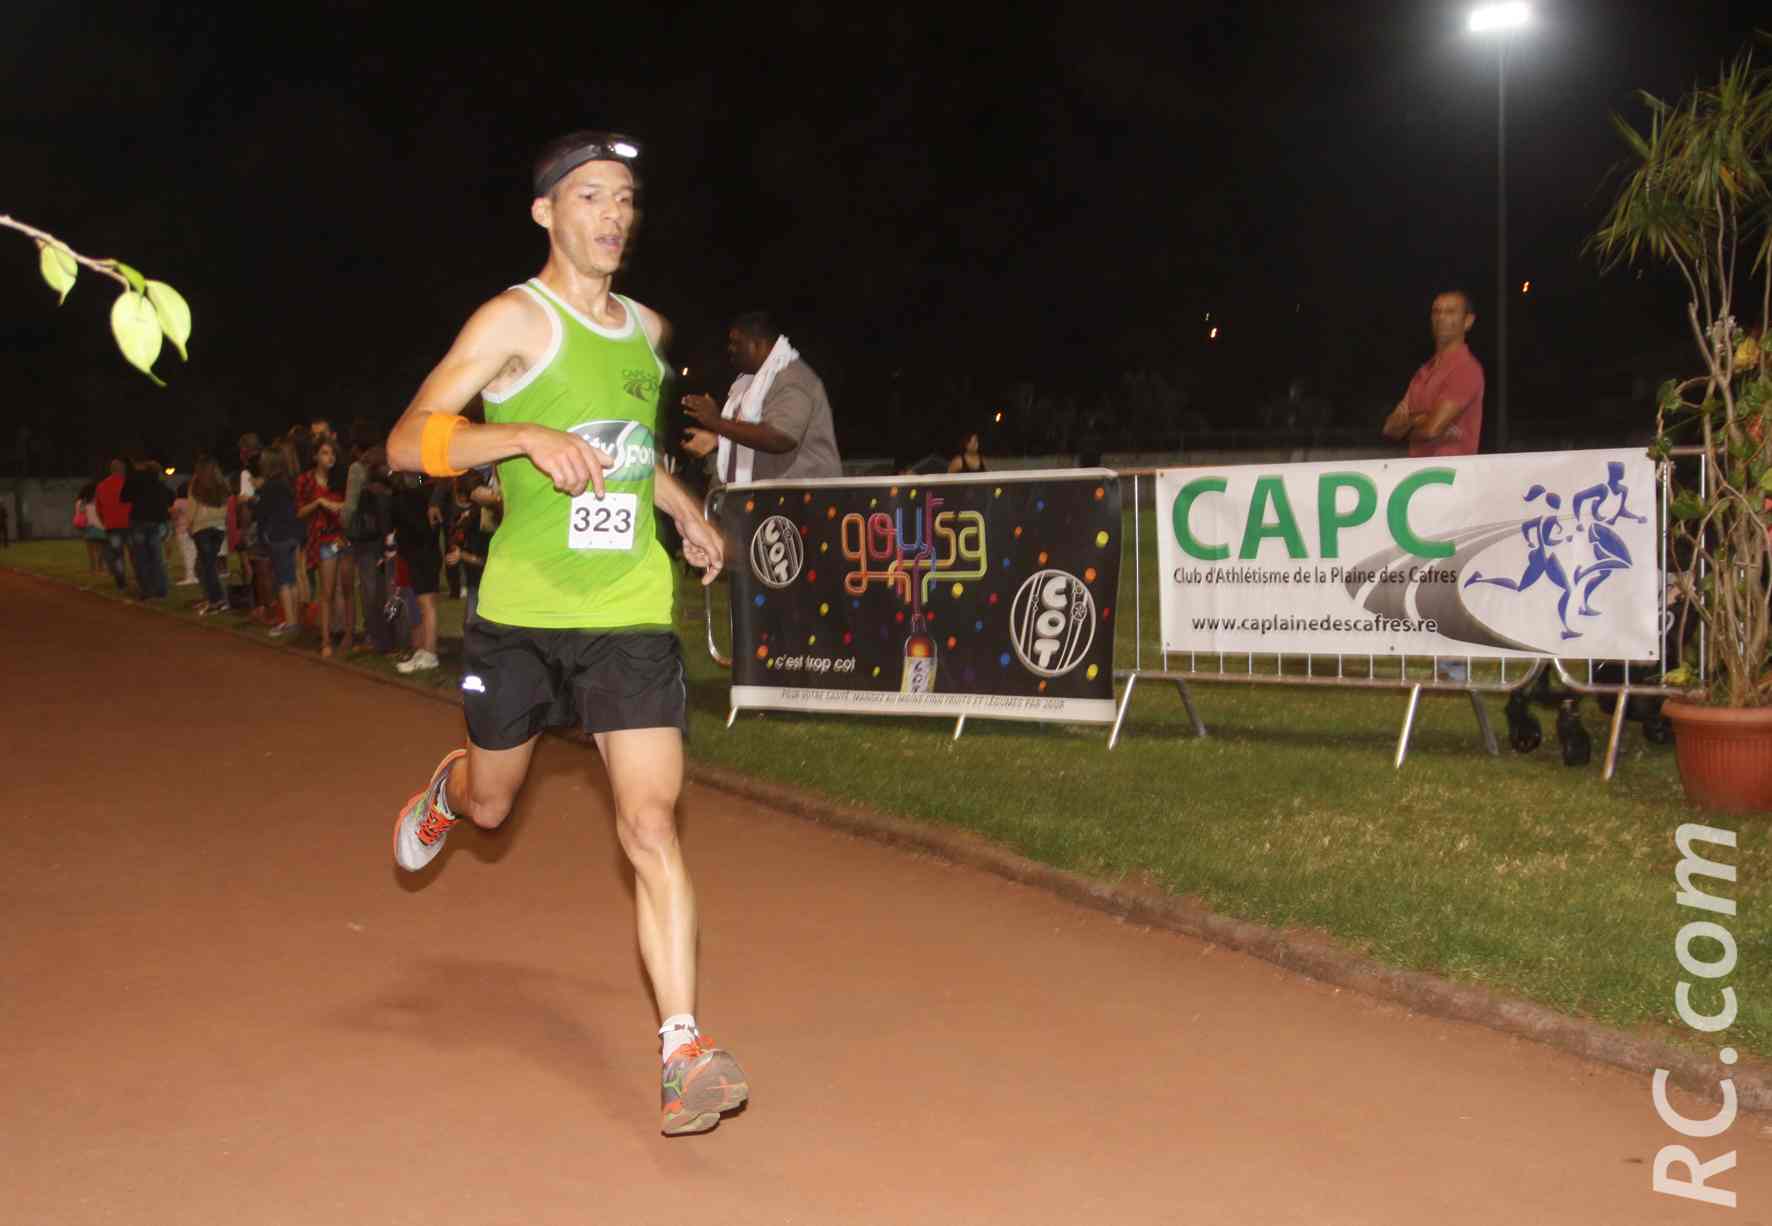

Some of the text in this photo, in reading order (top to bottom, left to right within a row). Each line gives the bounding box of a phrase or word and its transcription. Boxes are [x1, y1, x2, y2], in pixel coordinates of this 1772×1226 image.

[573, 507, 631, 533] 323
[1172, 466, 1457, 561] CAPC
[1173, 565, 1457, 584] Club d'Athlétisme de la Plaine des Cafres
[1032, 575, 1069, 668] COT
[1192, 614, 1436, 635] www.caplainedescafres.re
